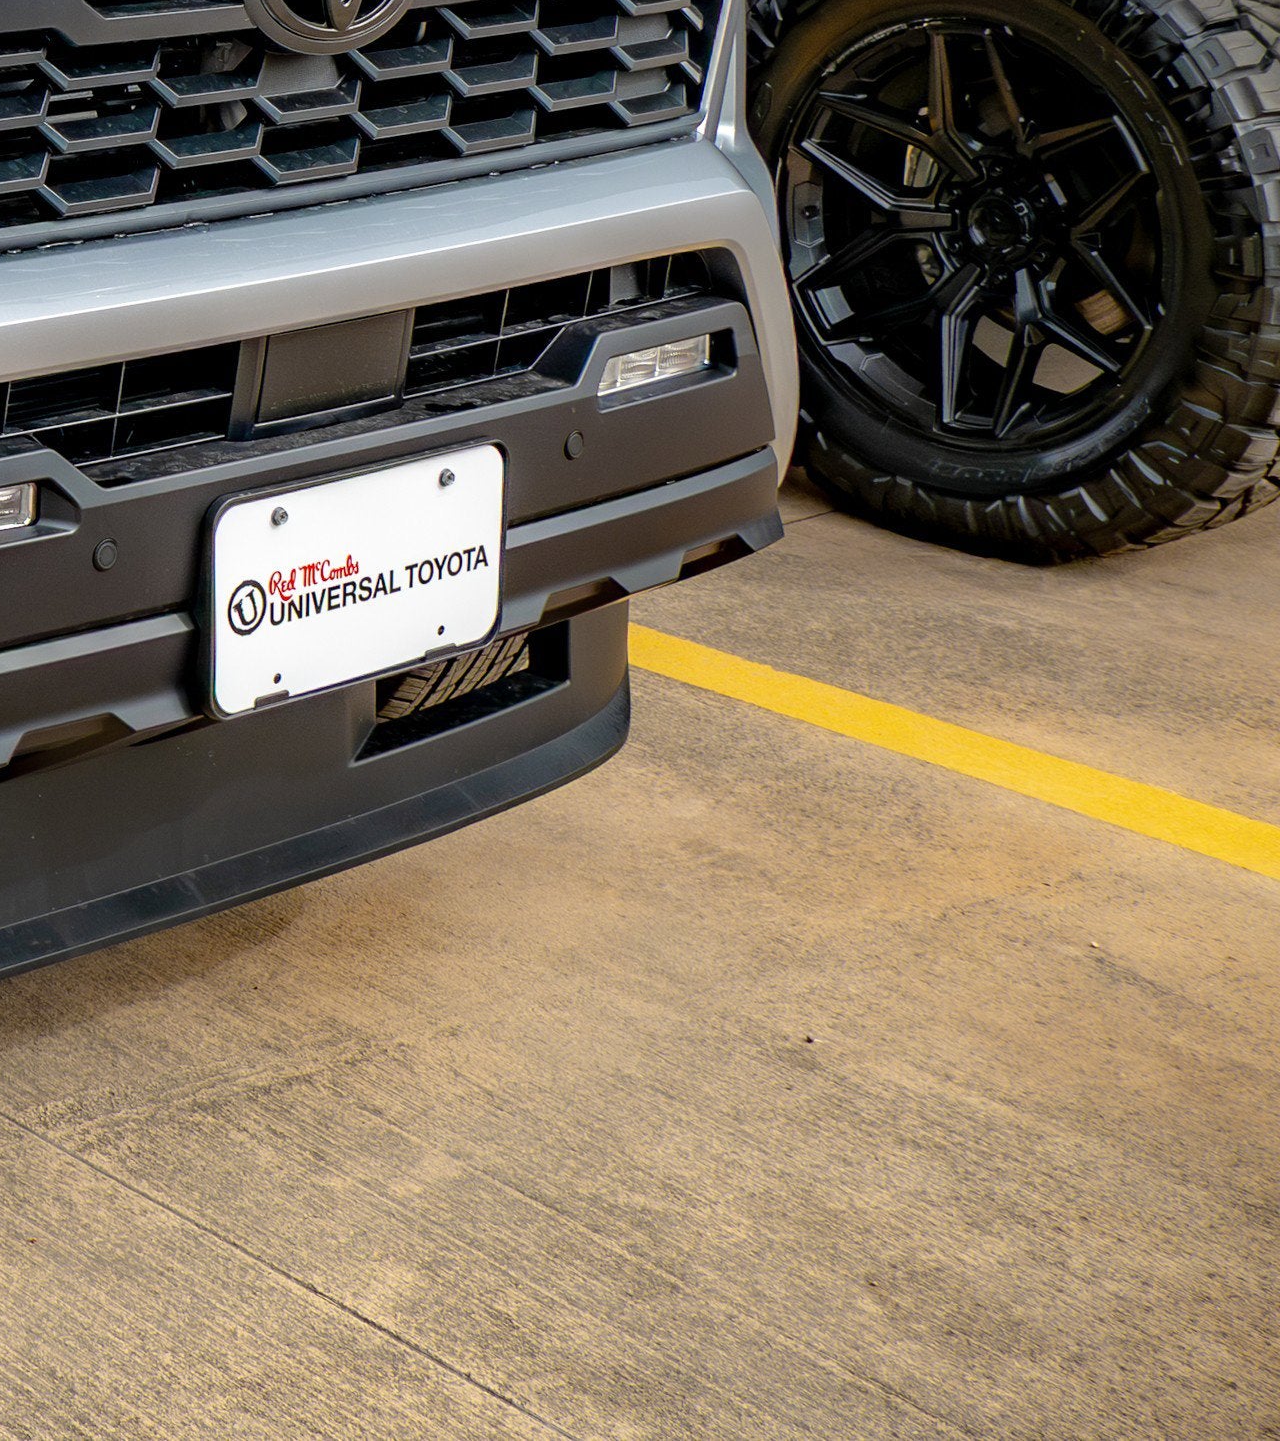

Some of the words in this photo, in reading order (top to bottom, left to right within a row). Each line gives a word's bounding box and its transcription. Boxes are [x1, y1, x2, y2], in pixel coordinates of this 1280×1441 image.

[269, 569, 296, 602] Red
[299, 554, 359, 588] McCombs
[270, 569, 402, 626] UNIVERSAL
[404, 545, 489, 588] TOYOTA
